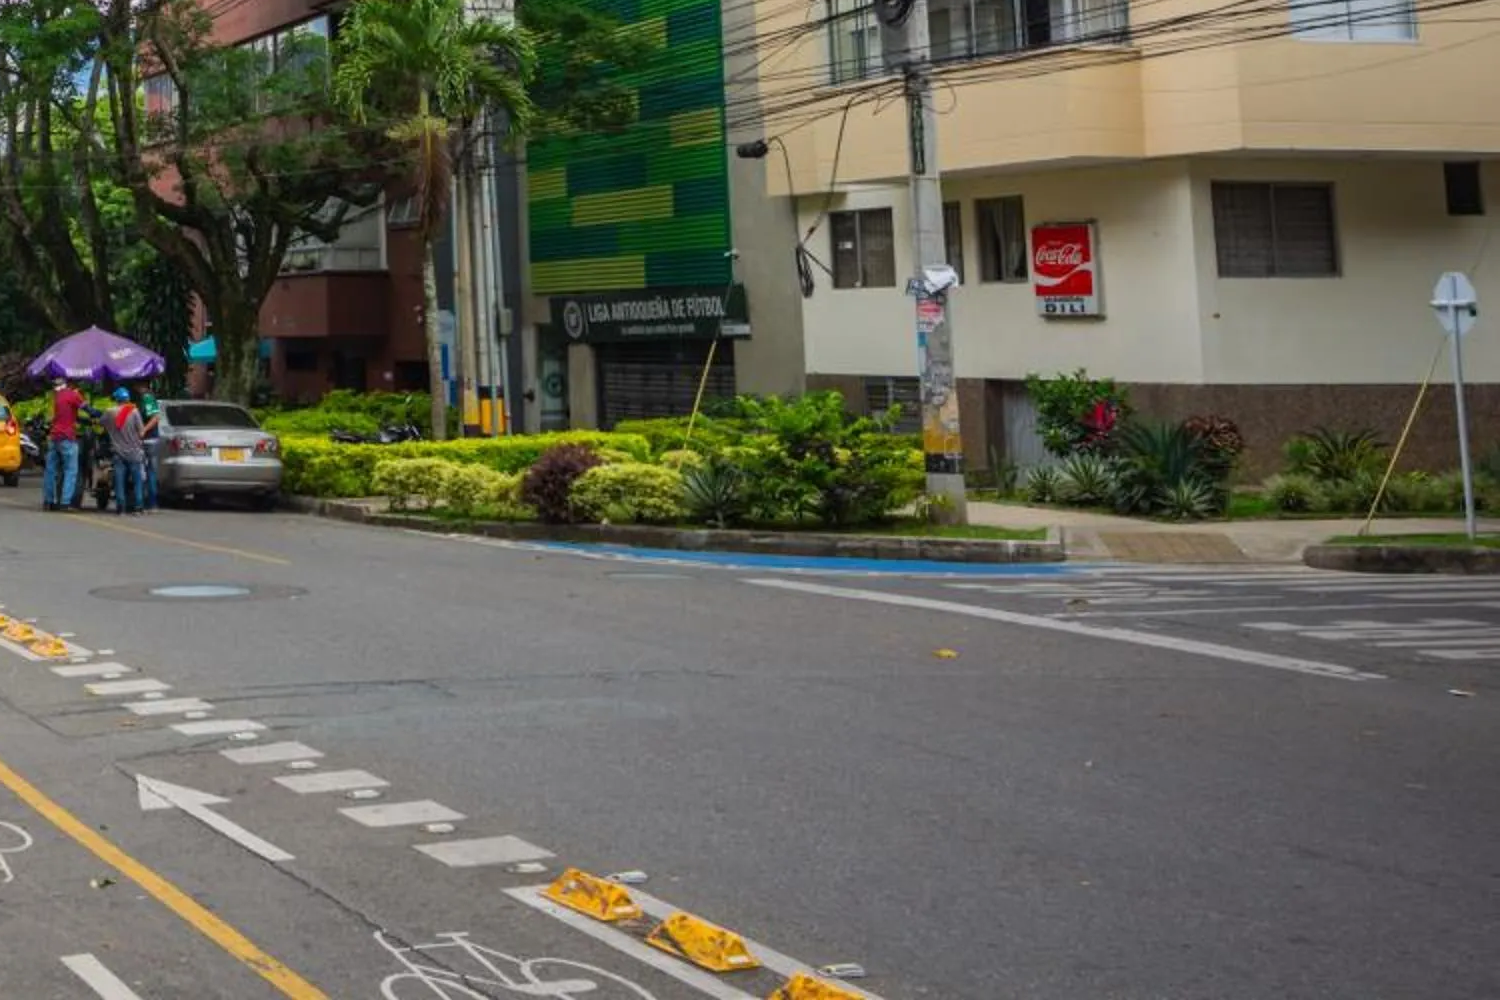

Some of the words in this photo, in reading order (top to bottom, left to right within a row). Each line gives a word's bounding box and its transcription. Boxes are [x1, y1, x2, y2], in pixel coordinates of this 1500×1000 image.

[1036, 244, 1082, 265] Coca-Cola
[589, 301, 611, 323] LIGA
[671, 299, 686, 318] DE
